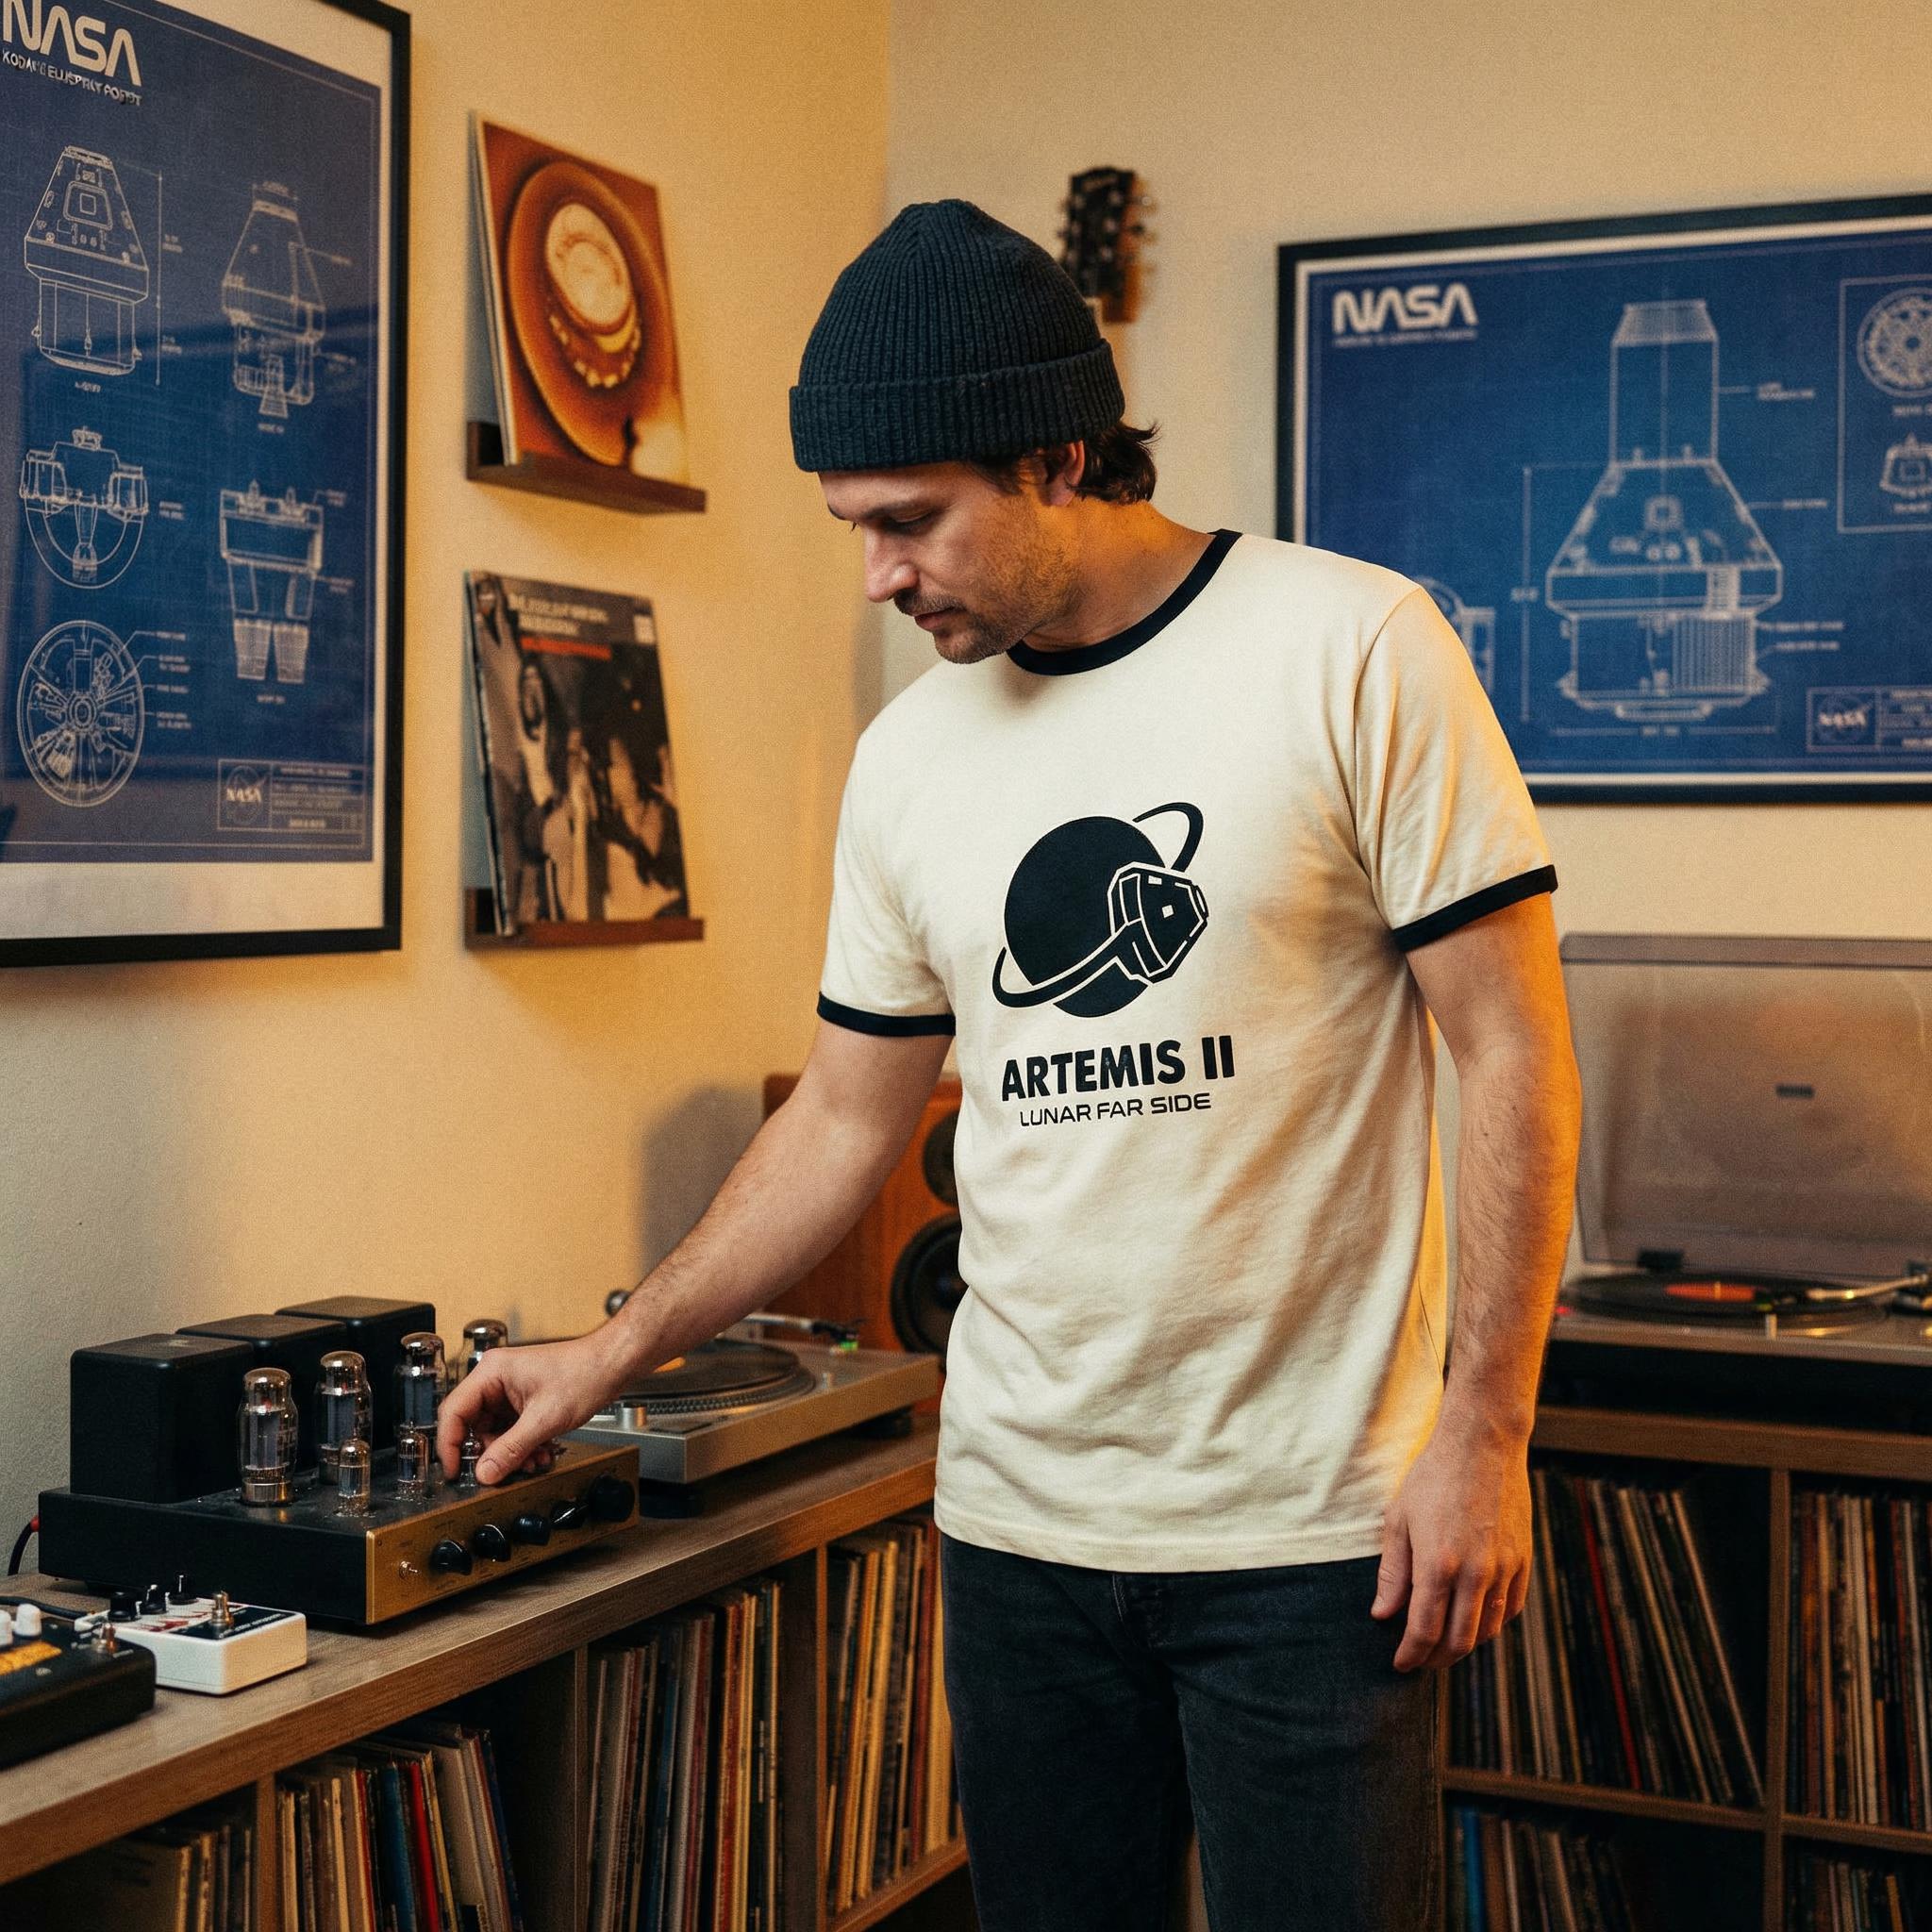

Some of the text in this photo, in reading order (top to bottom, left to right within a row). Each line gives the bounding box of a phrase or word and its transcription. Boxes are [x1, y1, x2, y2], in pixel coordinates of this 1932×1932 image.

[3, 0, 142, 87] NASA
[1332, 282, 1478, 335] NASA
[1002, 1035, 1235, 1101] ARTEMIS II
[1020, 1092, 1212, 1126] LUNAR FAR SIDE
